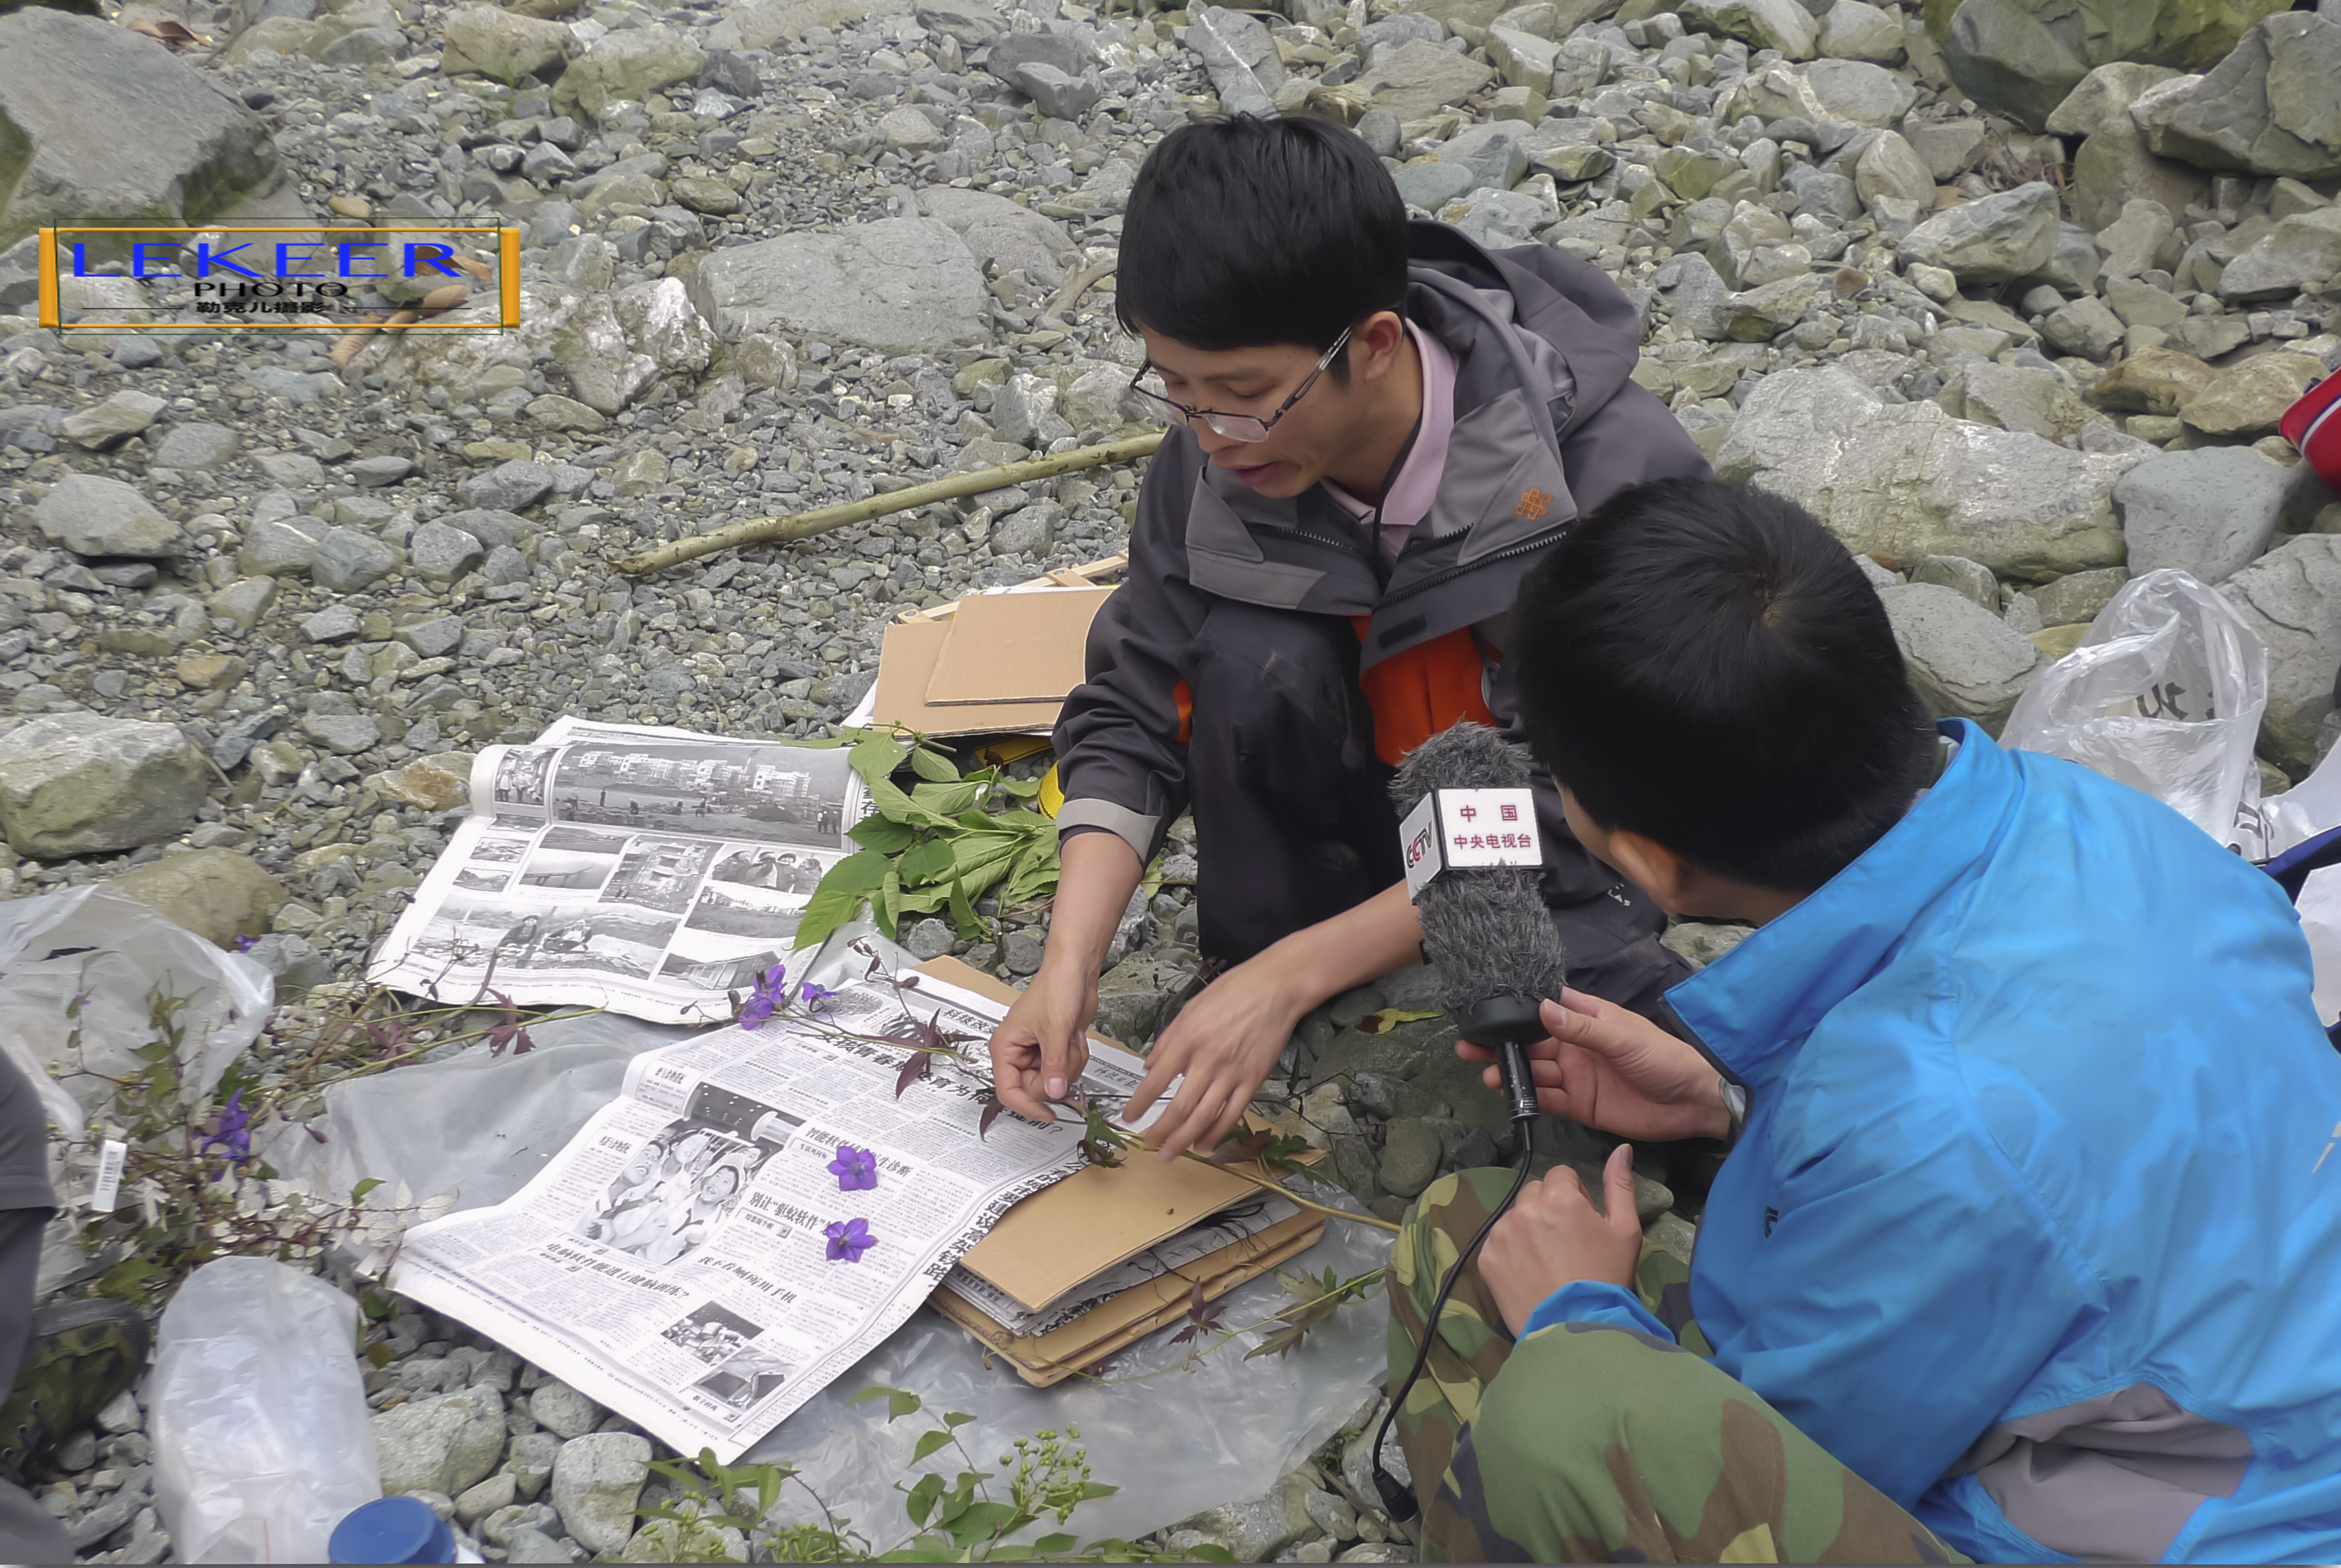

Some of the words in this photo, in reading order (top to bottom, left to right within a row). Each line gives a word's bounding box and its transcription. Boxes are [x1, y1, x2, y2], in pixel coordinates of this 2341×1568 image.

[1406, 821, 1432, 869] CCTV
[1454, 834, 1531, 849] 中央电视台
